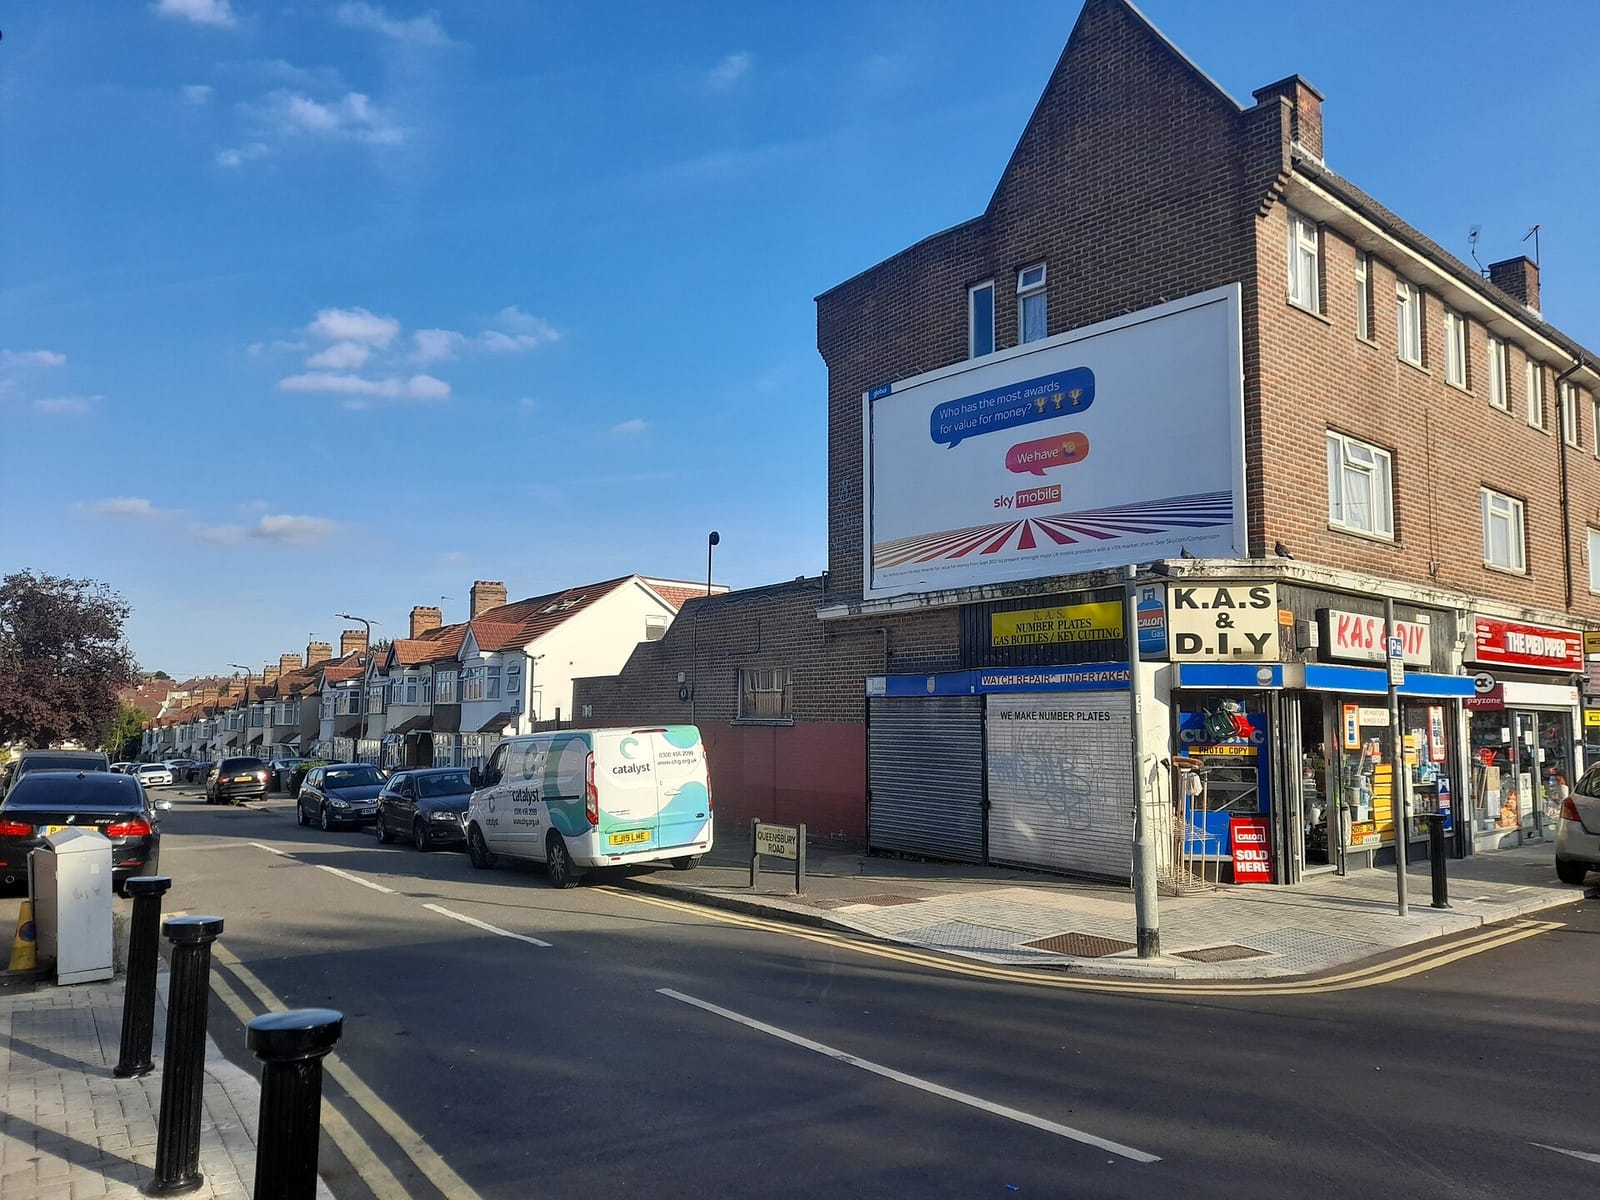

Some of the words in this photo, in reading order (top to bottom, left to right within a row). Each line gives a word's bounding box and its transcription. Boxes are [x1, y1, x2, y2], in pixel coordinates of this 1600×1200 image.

[939, 406, 960, 420] Who
[961, 402, 977, 416] has
[979, 397, 995, 411] the
[996, 391, 1022, 406] most
[1023, 381, 1060, 399] awards
[939, 423, 953, 435] for
[954, 418, 977, 432] value
[979, 413, 994, 425] for
[995, 403, 1032, 422] money?
[1017, 452, 1033, 464] We
[1034, 448, 1059, 461] have
[993, 494, 1014, 509] sky
[1018, 487, 1059, 504] mobile
[1174, 587, 1271, 610] K.A.S
[1016, 621, 1054, 634] NUMBER
[1058, 618, 1092, 631] PLATES
[1138, 616, 1164, 627] CALOR
[1216, 612, 1235, 629] &
[993, 635, 1009, 646] GAS
[1011, 631, 1049, 645] BOTTLES
[1055, 630, 1077, 642] KEY
[1078, 627, 1120, 640] CUTTING
[1151, 630, 1165, 638] Gas
[1337, 614, 1375, 649] KAS
[1396, 623, 1424, 655] DIY
[1175, 632, 1272, 655] D.I.Y
[1505, 631, 1525, 655] THE
[1525, 634, 1544, 657] PIED
[1544, 637, 1567, 658] PIPER
[983, 675, 1014, 685] WATCH
[1060, 671, 1130, 683] UNDERTAKEN
[1467, 697, 1501, 705] payzone
[1000, 711, 1013, 720] WE
[1014, 711, 1037, 721] MAKE
[1039, 711, 1074, 721] NUMBER
[1076, 711, 1111, 721] PLATES
[1198, 746, 1224, 754] PHOTO
[1229, 746, 1248, 754] COPY
[612, 763, 651, 775] catalyst
[512, 787, 540, 806] catalyst
[757, 831, 796, 845] QUEENSBURY
[1238, 833, 1264, 842] CALOR
[768, 843, 785, 854] ROAD
[1236, 850, 1268, 861] SOLD
[1236, 861, 1270, 873] HERE
